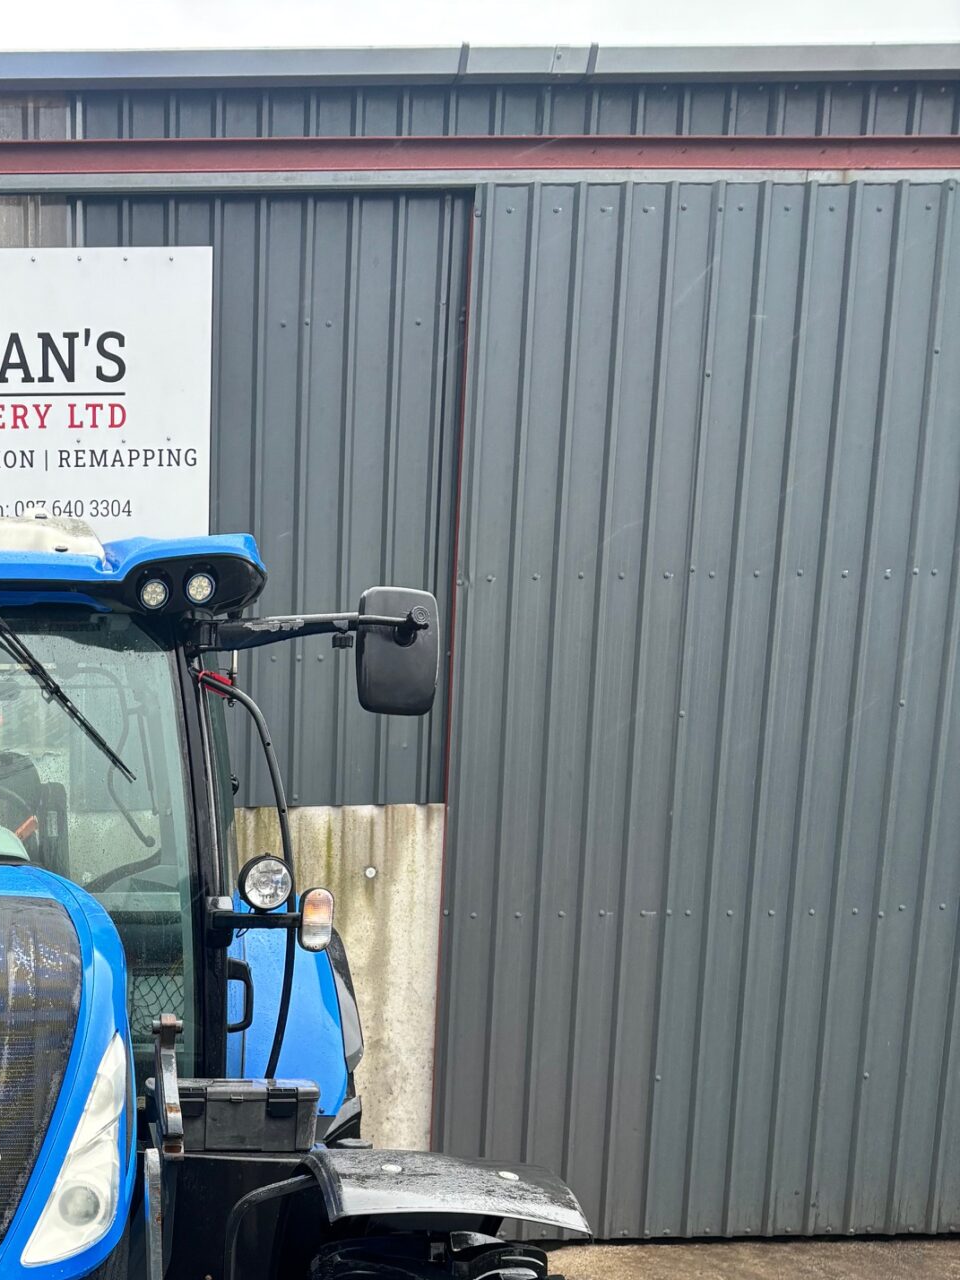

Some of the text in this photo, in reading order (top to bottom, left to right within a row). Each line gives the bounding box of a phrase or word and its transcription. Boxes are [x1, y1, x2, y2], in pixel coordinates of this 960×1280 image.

[67, 403, 127, 429] LTD
[58, 448, 198, 468] REMAPPING
[52, 499, 84, 518] 640
[89, 499, 132, 518] 3304
